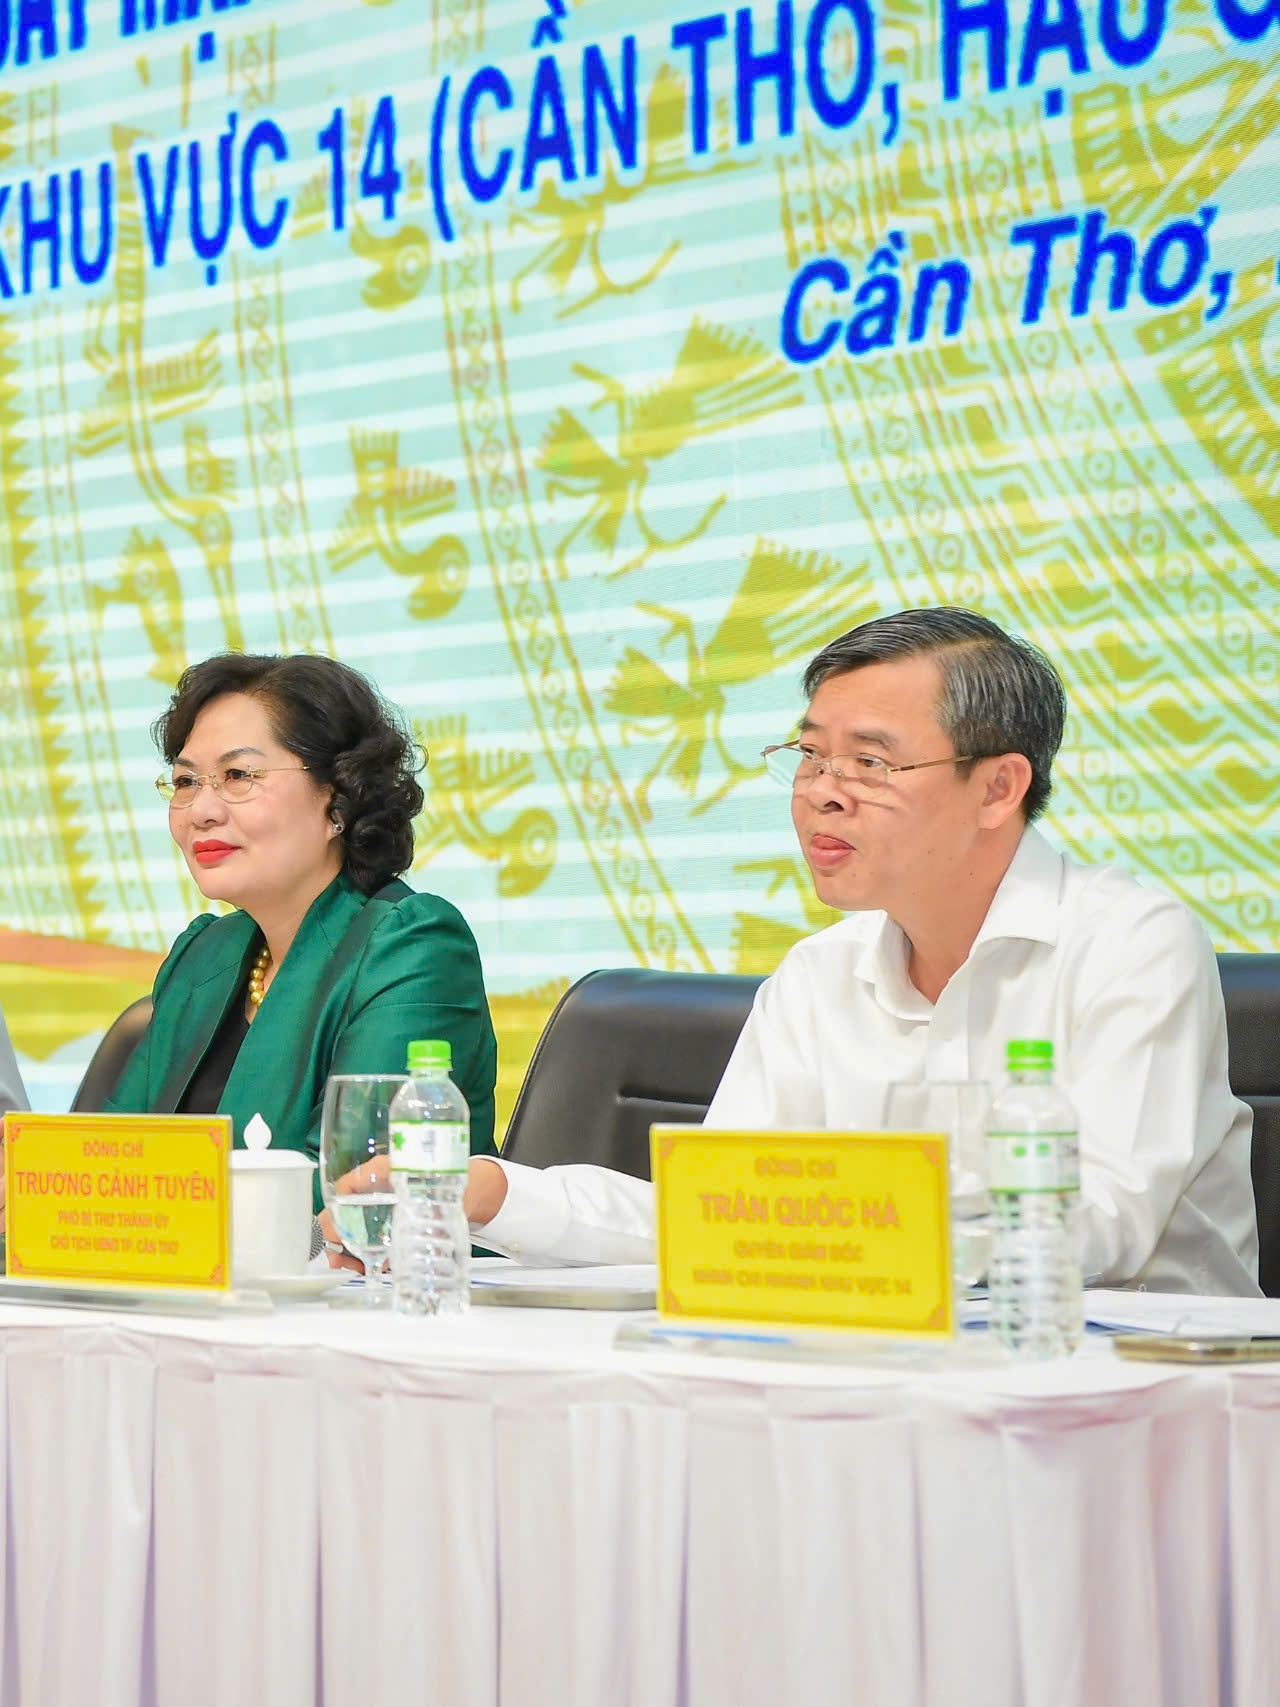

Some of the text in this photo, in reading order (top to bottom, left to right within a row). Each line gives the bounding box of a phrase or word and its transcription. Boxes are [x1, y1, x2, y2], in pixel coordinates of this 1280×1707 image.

[138, 113, 288, 286] VỰC
[319, 97, 400, 230] 14
[783, 206, 1231, 362] Cần Thơ,
[16, 1170, 92, 1196] TRƯƠNG
[154, 1170, 216, 1201] TUYÊN
